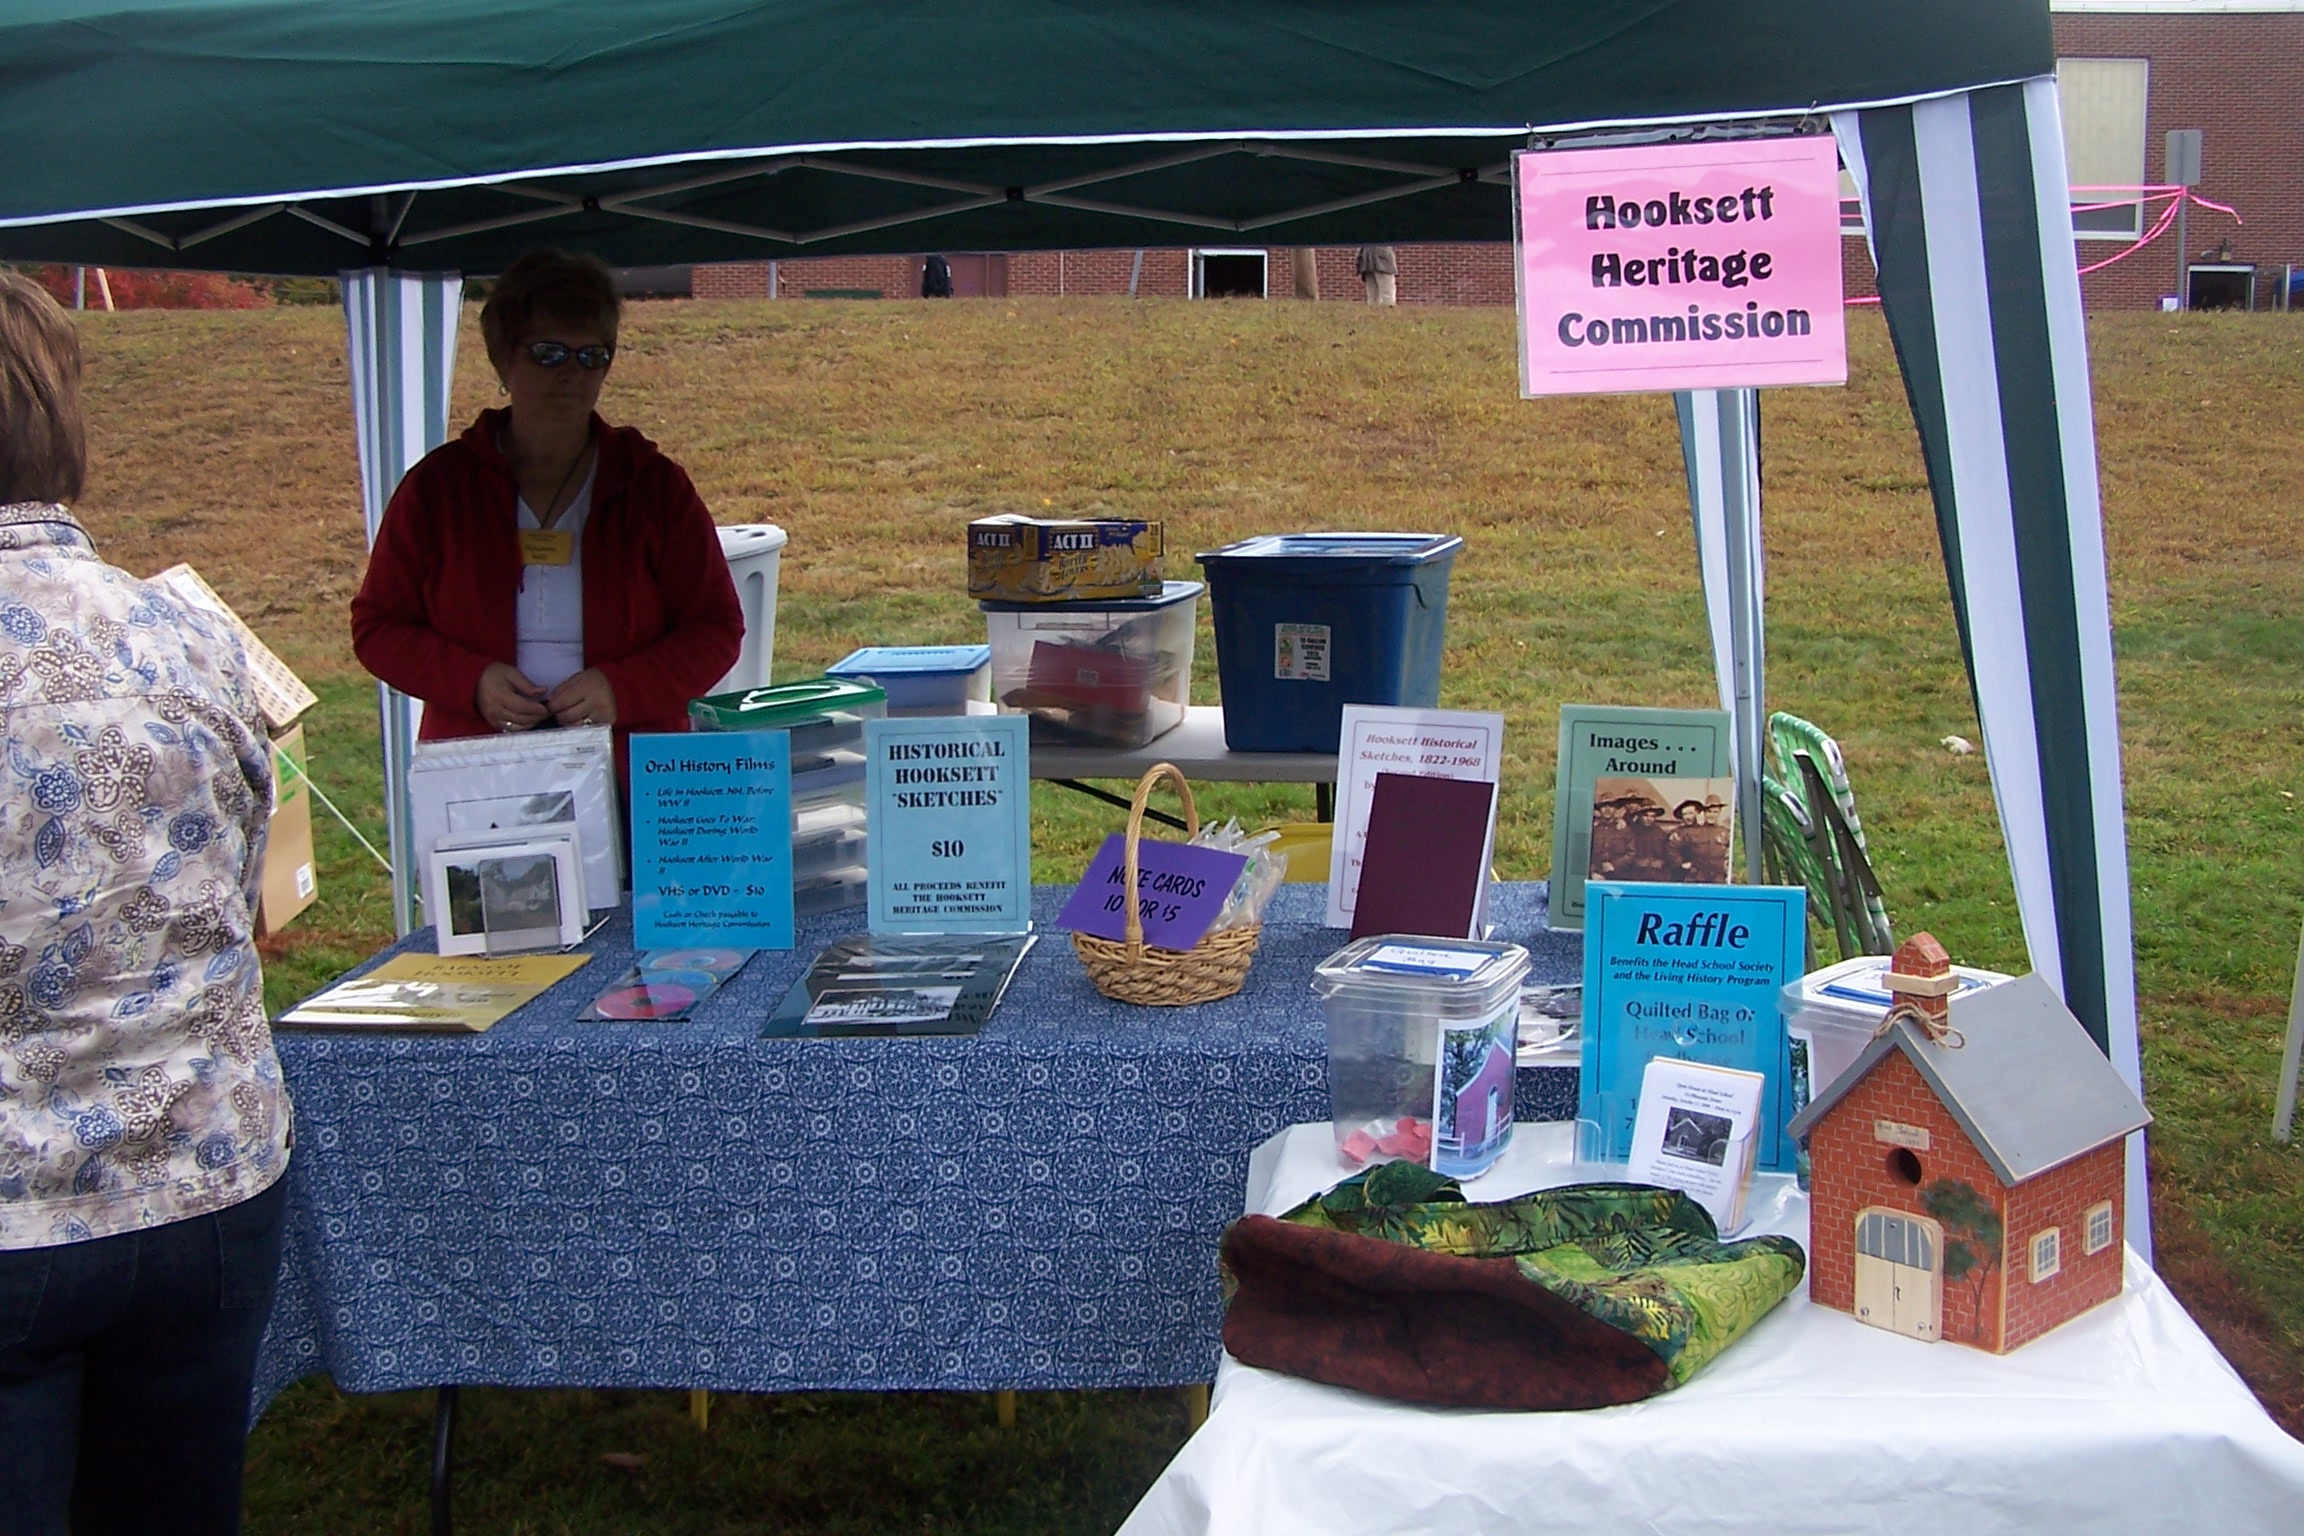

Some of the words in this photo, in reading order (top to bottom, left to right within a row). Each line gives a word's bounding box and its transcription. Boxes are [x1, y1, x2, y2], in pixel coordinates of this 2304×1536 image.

[1585, 185, 1774, 230] Hooksett
[1591, 247, 1773, 288] Heritage
[1557, 302, 1811, 347] Commission
[977, 533, 997, 546] ACT
[999, 533, 1010, 547] II
[1054, 533, 1077, 550] ACT
[1079, 534, 1094, 549] II
[888, 741, 1005, 760] HISTORICAL
[1366, 734, 1418, 745] Hooksett
[1421, 737, 1477, 749] Historical
[645, 759, 675, 773] Oral
[680, 759, 731, 775] History
[735, 757, 776, 771] Films
[1419, 754, 1481, 767] 1822-1968
[1605, 758, 1676, 774] Around
[895, 765, 999, 784] HOOKSETT
[931, 840, 964, 858] $10
[658, 886, 685, 896] VHS
[687, 888, 700, 896] or
[703, 885, 730, 896] DVD
[746, 884, 765, 896] $10
[892, 882, 909, 891] ALL
[913, 882, 962, 891] PROCEEDS
[966, 881, 1006, 890] BENEFIT
[1153, 872, 1206, 898] CARDS
[913, 894, 931, 902] THE
[936, 893, 986, 902] HOOKSETT
[893, 905, 939, 914] HERITAGE
[943, 904, 1003, 913] COMMISSION
[1103, 894, 1125, 912] 10
[1161, 904, 1182, 922] $5
[1636, 912, 1749, 949] Raffle
[1610, 956, 1650, 967] Benefits
[1652, 958, 1669, 968] the
[1671, 959, 1699, 969] Head
[1701, 959, 1736, 970] School
[1738, 961, 1775, 973] Society
[1613, 970, 1633, 980] and
[1634, 970, 1651, 981] the
[1654, 971, 1684, 984] Living
[1687, 973, 1724, 986] History
[1726, 974, 1771, 987] Program
[1625, 1000, 1691, 1019] Quilted
[1698, 1003, 1730, 1024] Bag
[1685, 1026, 1745, 1045] School
